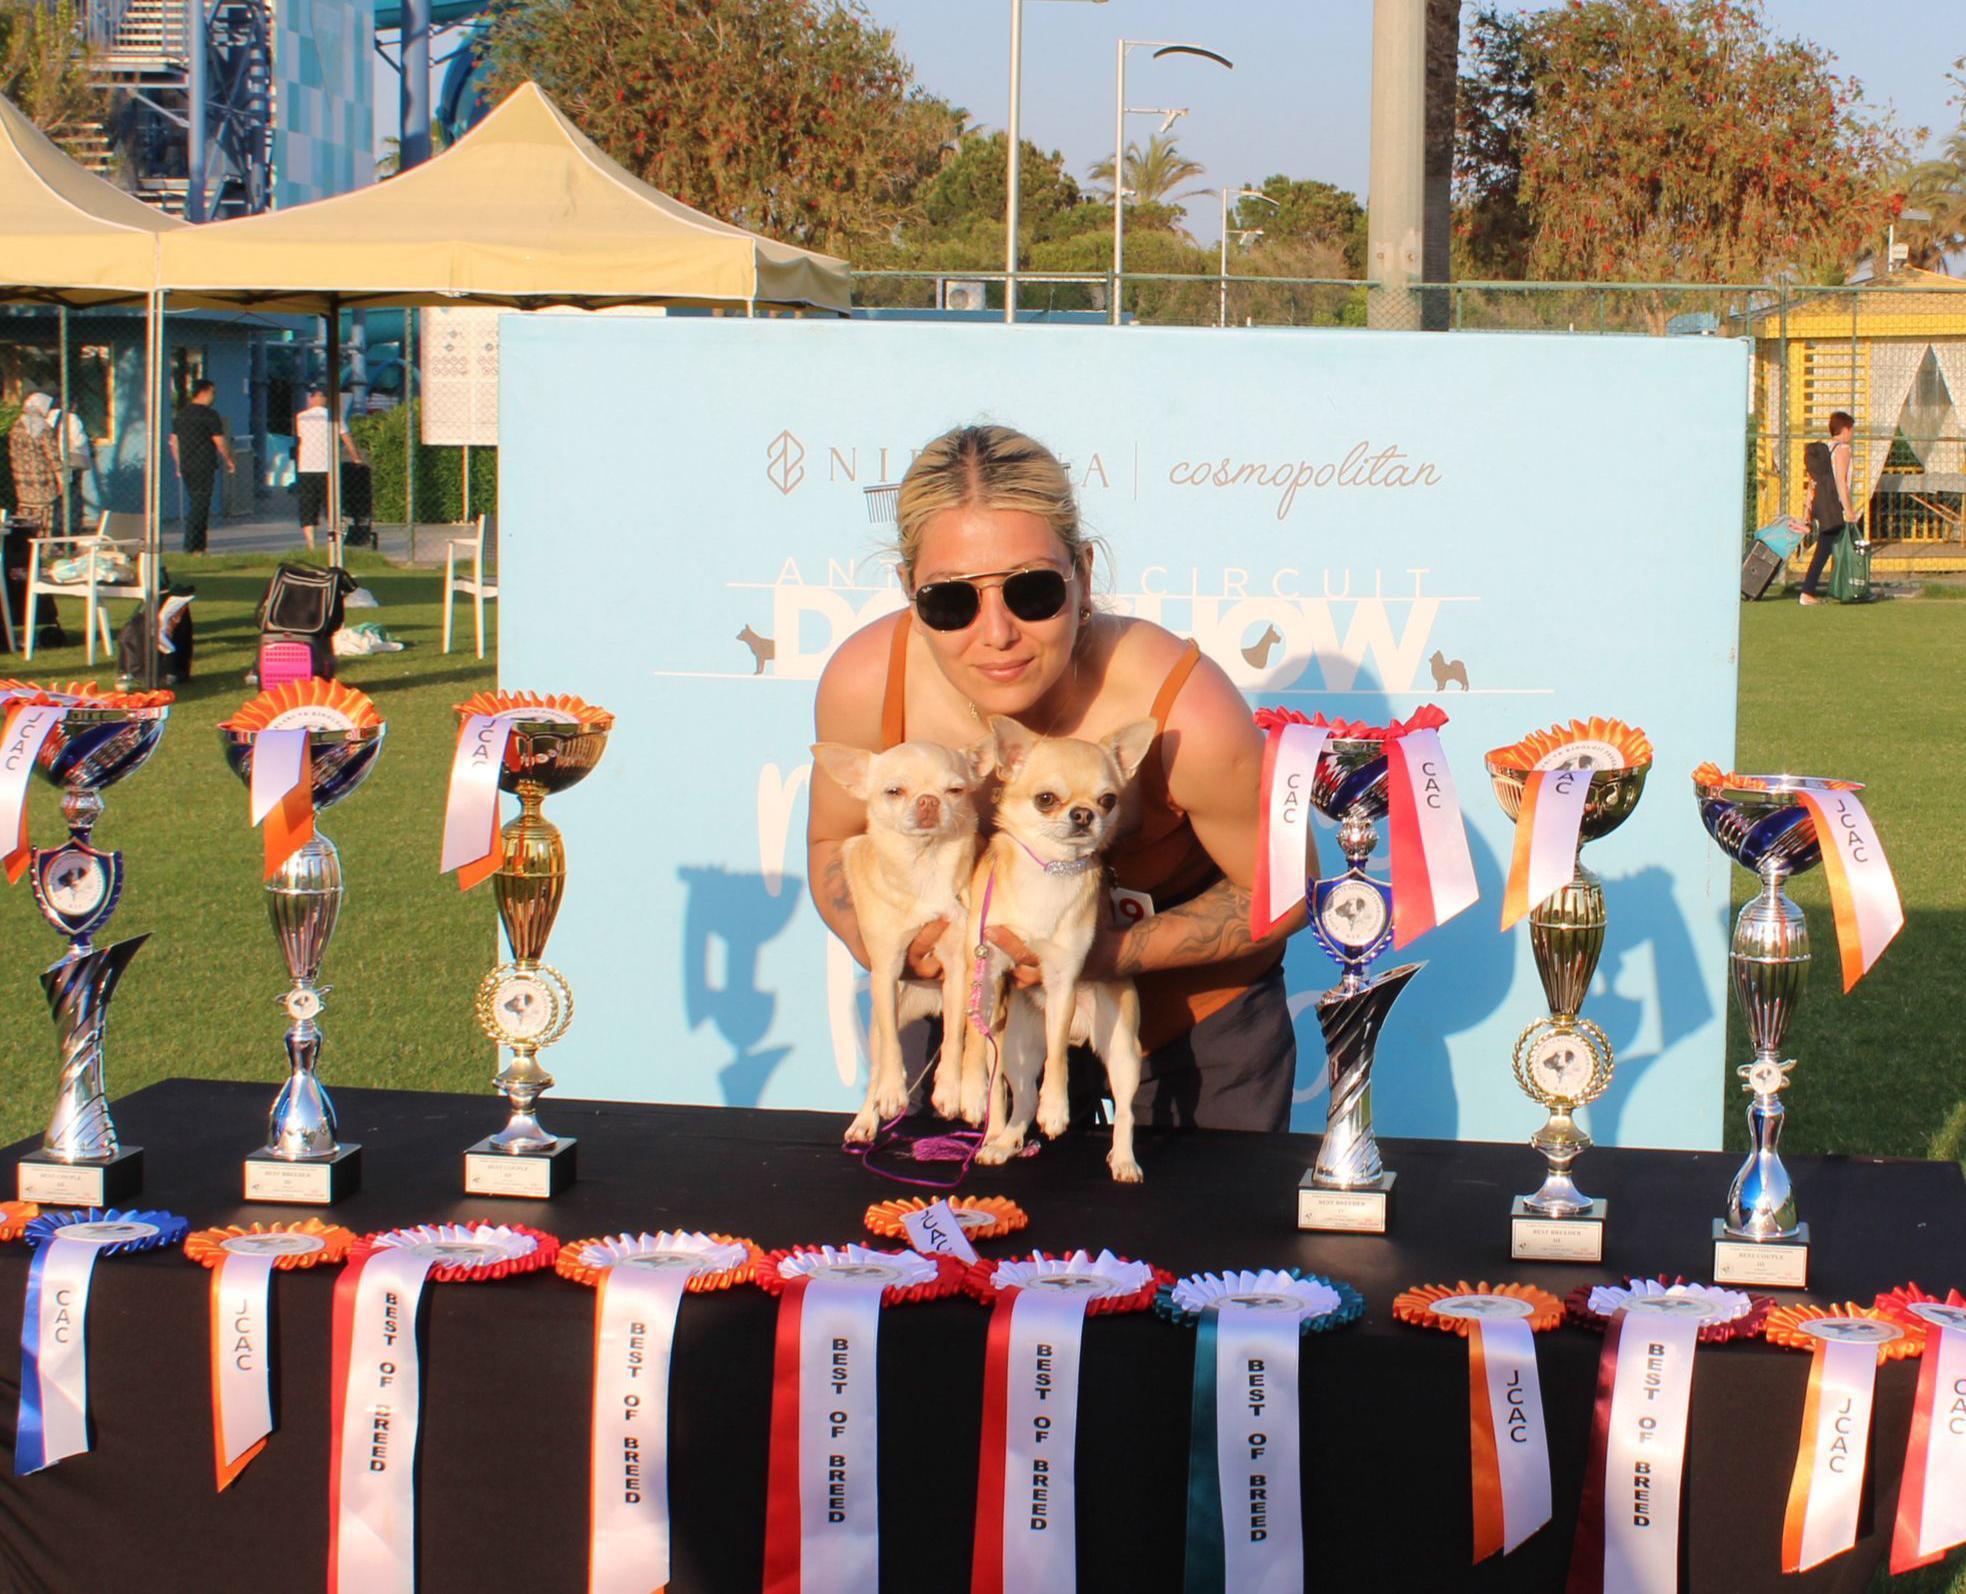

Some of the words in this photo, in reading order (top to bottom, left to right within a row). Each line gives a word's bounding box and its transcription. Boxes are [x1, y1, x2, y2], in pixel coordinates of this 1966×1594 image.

[1169, 441, 1442, 520] cosmopolitan
[1140, 565, 1431, 598] CIRCUIT
[1093, 597, 1440, 693] HOW
[5, 711, 45, 771] JCAC
[1283, 774, 1301, 824] CAC
[1421, 762, 1441, 809] CAC
[1836, 799, 1869, 863] JCAC
[55, 1289, 72, 1345] CAC
[233, 1300, 253, 1372] JCAC
[385, 1292, 398, 1347] BEST
[379, 1362, 395, 1388] OF
[627, 1322, 646, 1379] BEST
[831, 1338, 849, 1394] BEST
[1035, 1343, 1053, 1400] BEST
[1645, 1343, 1665, 1400] BEST
[625, 1394, 640, 1421] OF
[1247, 1359, 1265, 1417] BEST
[1506, 1370, 1528, 1443] JCAC
[1949, 1378, 1966, 1435] CAC
[828, 1411, 848, 1438] OF
[1033, 1416, 1051, 1443] OF
[1247, 1433, 1267, 1460] OF
[1638, 1417, 1657, 1443] OF
[1828, 1398, 1852, 1474] JCAC
[624, 1437, 640, 1504] BREED
[827, 1454, 847, 1524] BREED
[1029, 1459, 1049, 1531] BREED
[1633, 1461, 1652, 1528] BREED
[1248, 1475, 1267, 1543] BREED
